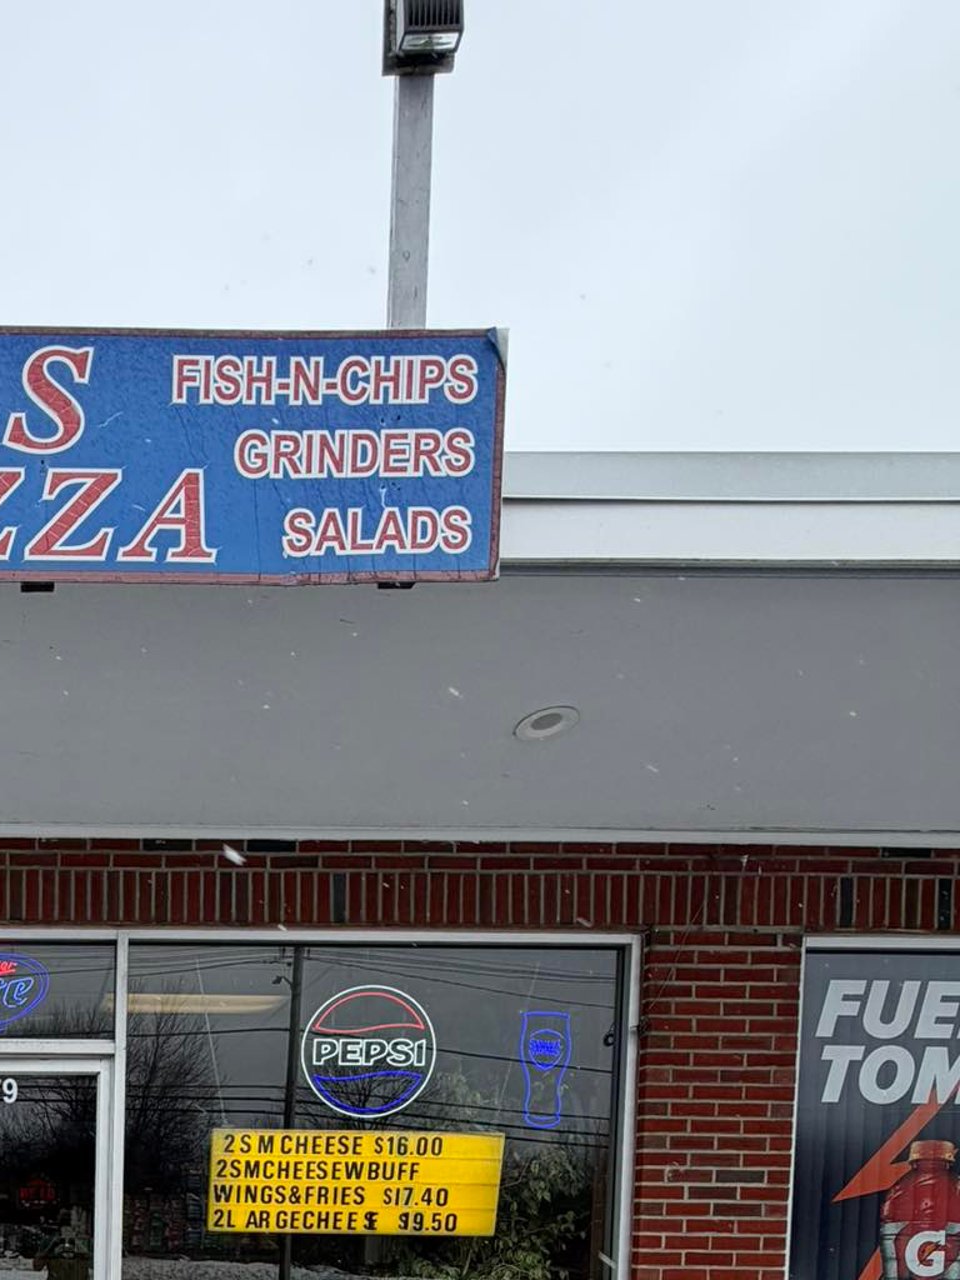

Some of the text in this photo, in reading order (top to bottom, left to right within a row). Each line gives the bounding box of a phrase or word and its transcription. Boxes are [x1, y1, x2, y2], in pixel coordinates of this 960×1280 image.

[170, 354, 479, 405] FISH-N-CHIPS
[234, 428, 476, 478] GRINDERS
[282, 505, 472, 558] SALADS
[815, 979, 960, 1040] FUE
[312, 1038, 427, 1067] PEPSI
[821, 1044, 960, 1105] TOM
[374, 1136, 443, 1156] $16.00
[213, 1184, 449, 1207] WINGS&FRIES $17.40
[904, 1230, 946, 1277] G
